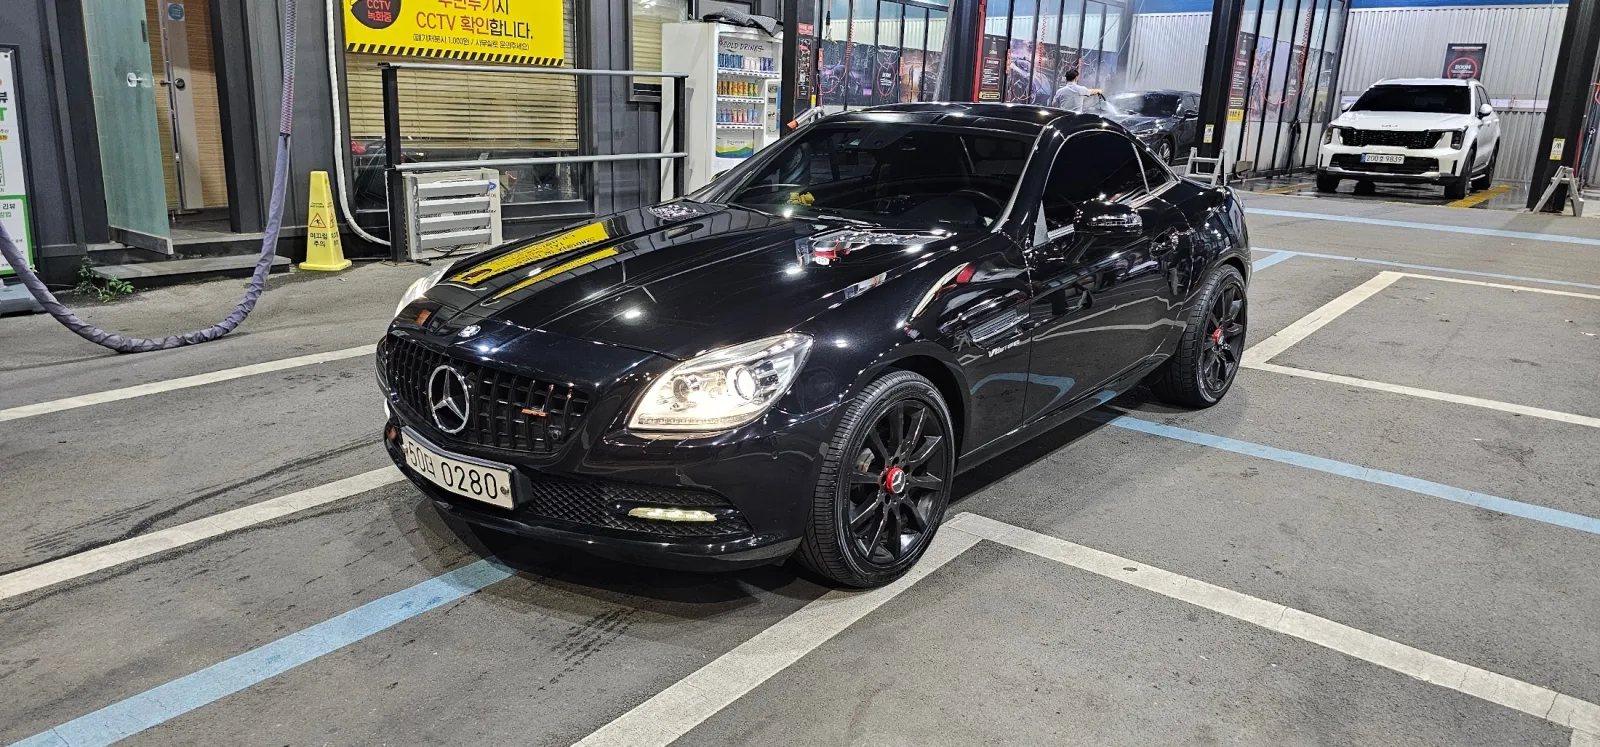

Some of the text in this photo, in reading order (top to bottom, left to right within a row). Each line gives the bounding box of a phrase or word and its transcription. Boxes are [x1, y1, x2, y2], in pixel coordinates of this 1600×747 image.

[367, 0, 391, 10] CCTV
[367, 10, 392, 22] 녹화중
[416, 11, 533, 39] CCTV 확인합니다.
[408, 441, 498, 500] 50더 0280
